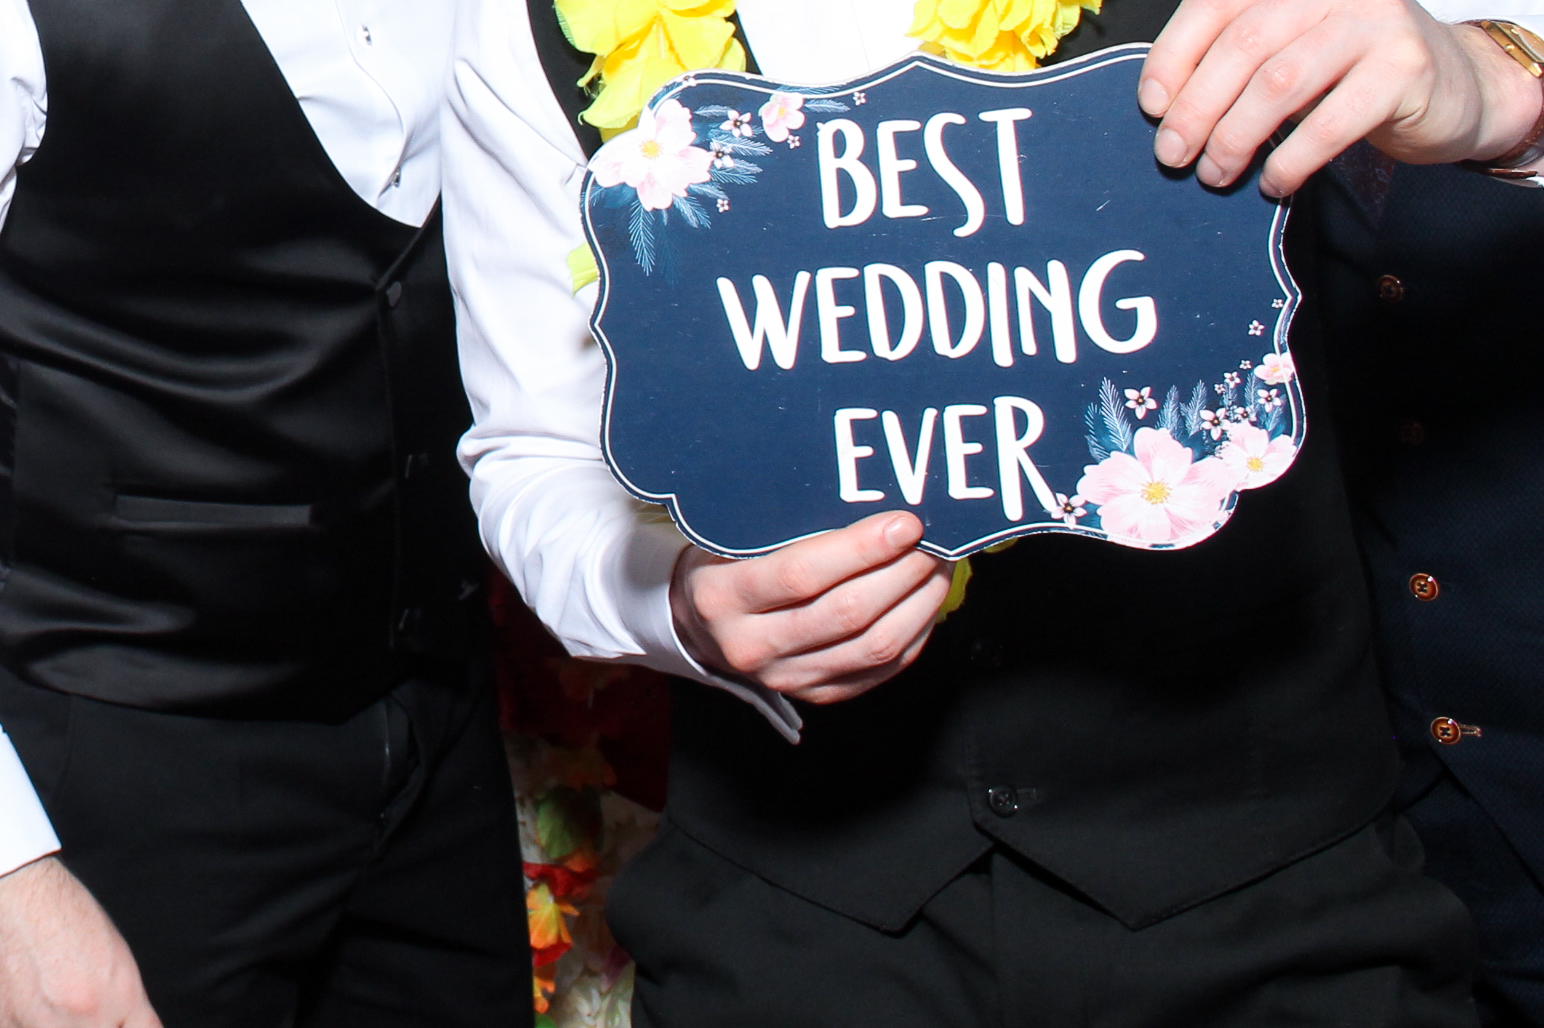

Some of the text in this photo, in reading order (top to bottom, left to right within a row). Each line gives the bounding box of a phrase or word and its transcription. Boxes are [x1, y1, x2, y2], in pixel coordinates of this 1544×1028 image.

[816, 107, 1033, 237] BEST
[716, 249, 1158, 371] WEDDING
[834, 395, 1058, 521] EVER
